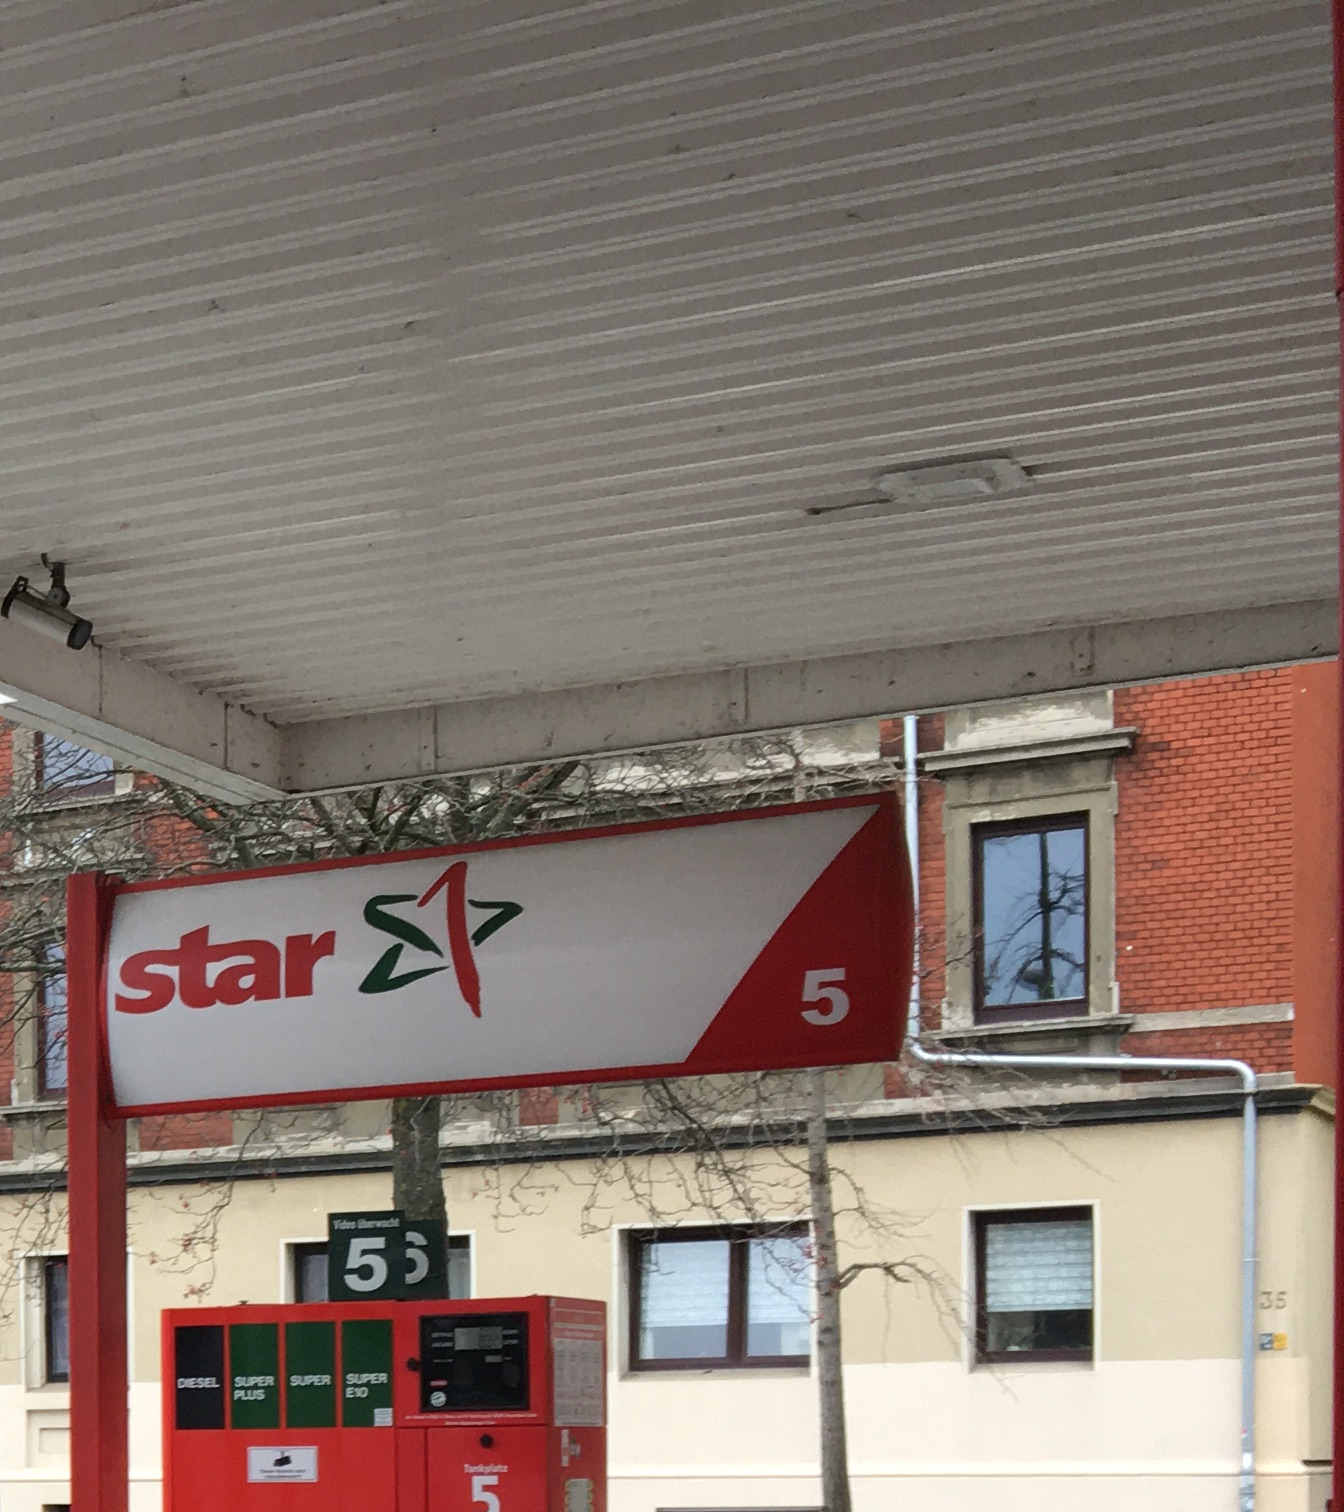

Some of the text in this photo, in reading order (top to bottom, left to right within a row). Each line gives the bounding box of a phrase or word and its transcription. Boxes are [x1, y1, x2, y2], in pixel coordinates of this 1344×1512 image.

[113, 924, 336, 1015] star
[800, 967, 851, 1027] 5
[344, 1237, 388, 1292] 5
[1260, 1291, 1287, 1309] 35
[177, 1377, 221, 1389] DIESEL
[234, 1375, 274, 1387] SUPER
[290, 1374, 331, 1386] SUPER
[345, 1372, 388, 1384] SUPER
[234, 1389, 265, 1401] PLUS
[345, 1387, 369, 1398] E10
